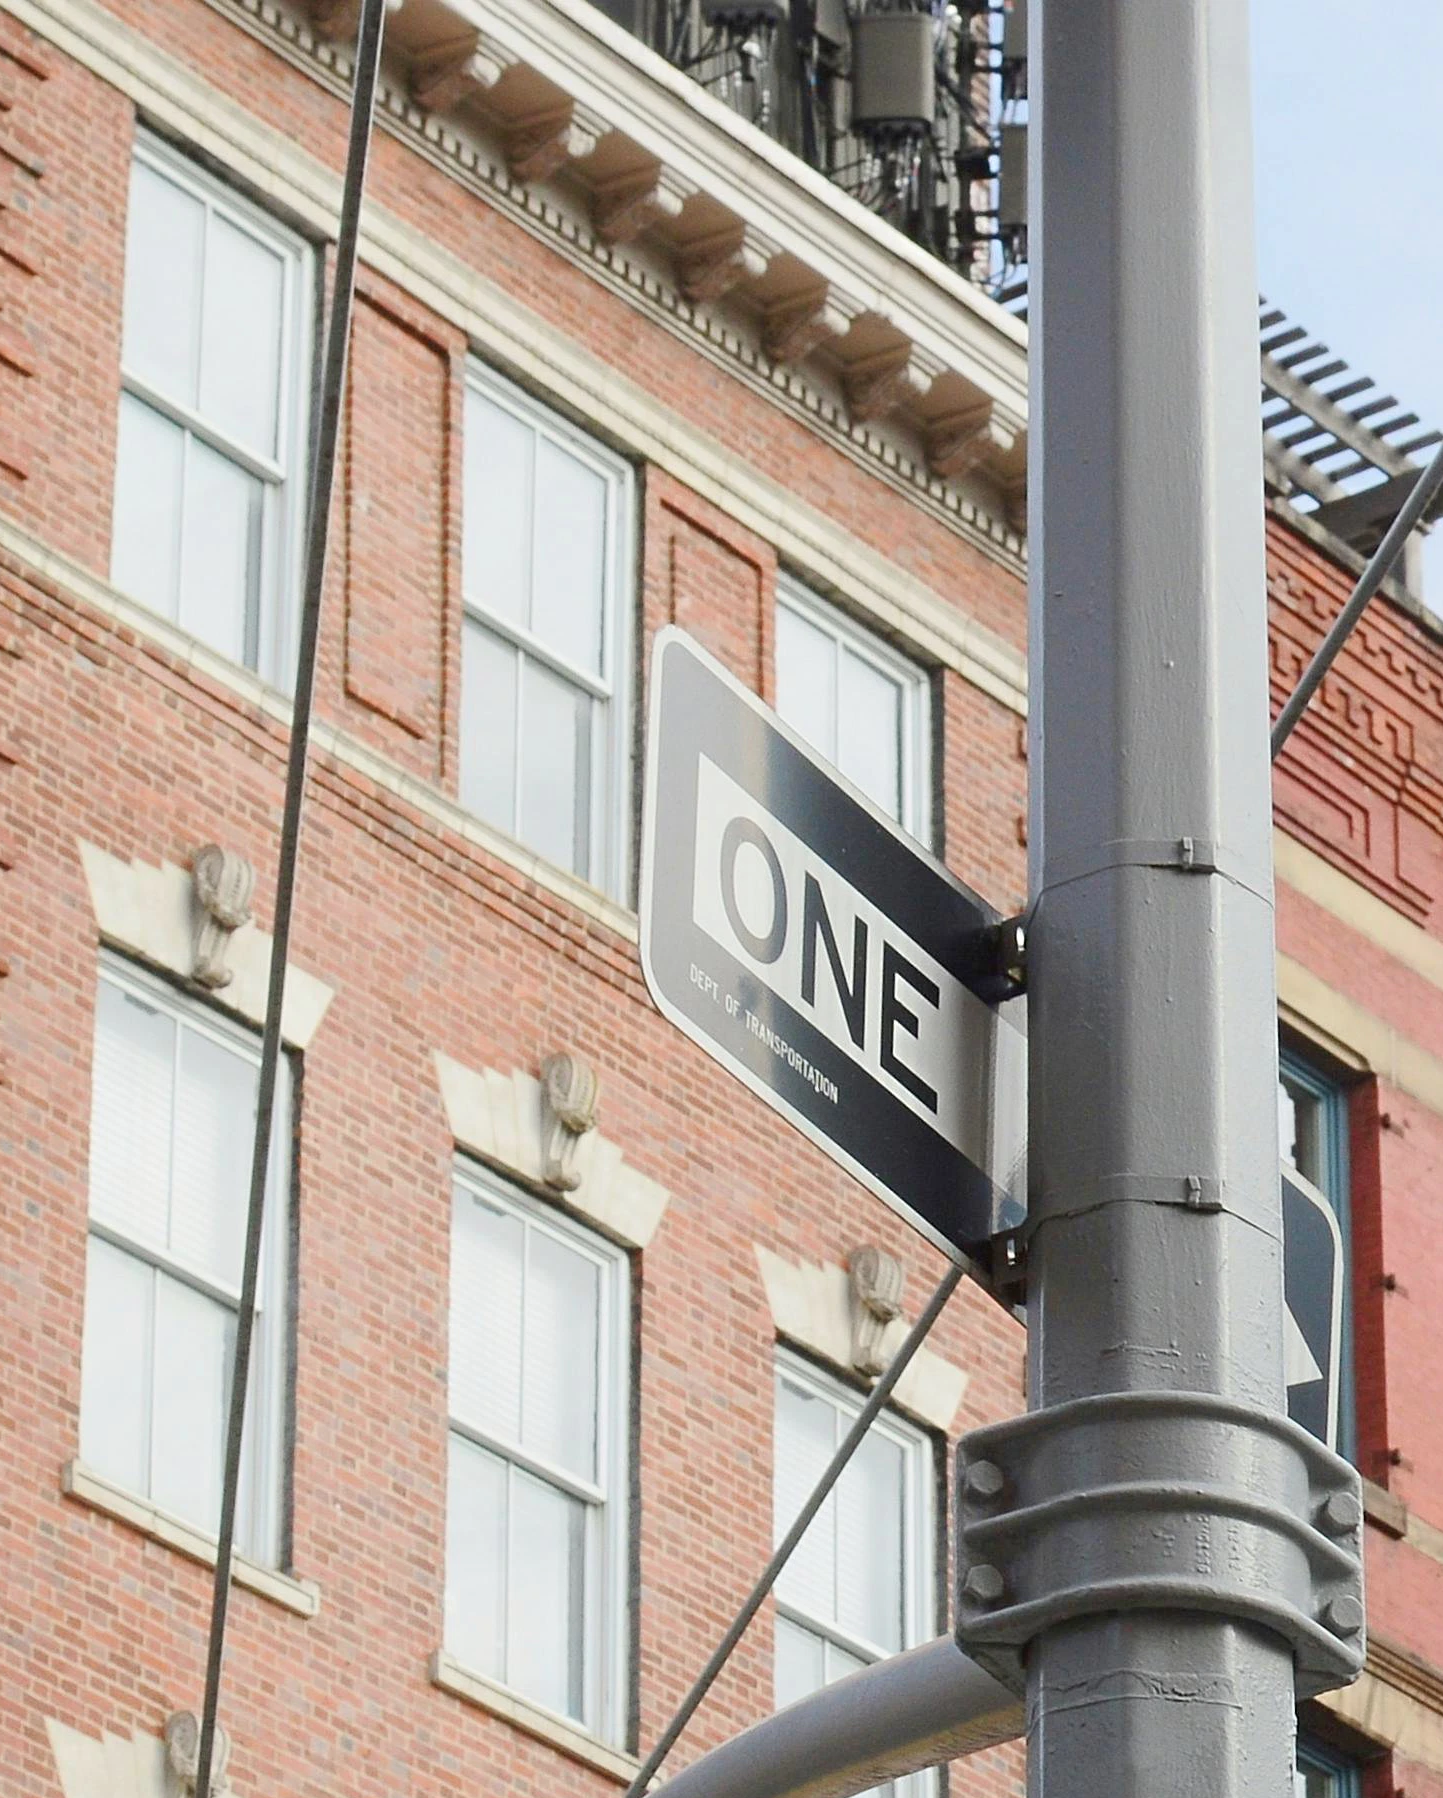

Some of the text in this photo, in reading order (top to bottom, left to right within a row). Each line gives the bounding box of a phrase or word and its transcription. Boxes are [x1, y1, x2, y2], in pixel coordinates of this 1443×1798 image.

[720, 816, 940, 1114] ONE
[725, 993, 740, 1017] OF
[745, 1009, 838, 1104] TRANSPORTATION
